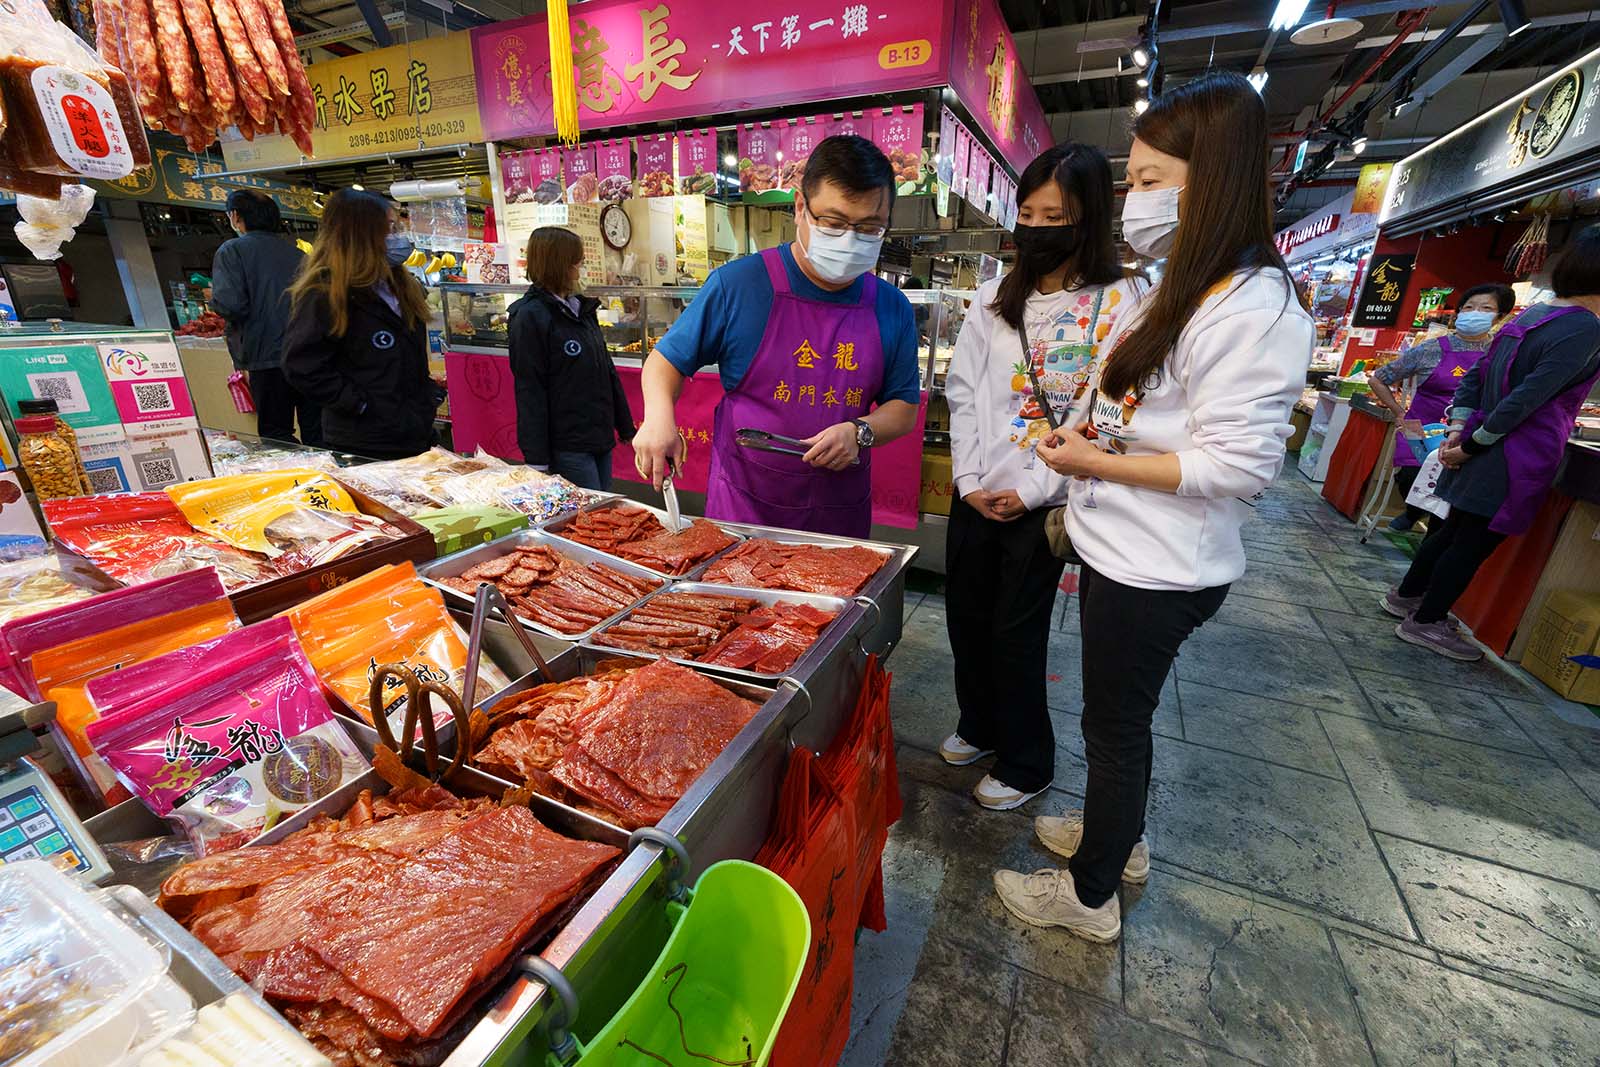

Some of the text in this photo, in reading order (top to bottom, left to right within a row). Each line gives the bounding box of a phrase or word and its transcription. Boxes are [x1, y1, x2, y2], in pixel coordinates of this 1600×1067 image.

[888, 46, 921, 64] B-13
[349, 119, 466, 148] 2396-4213/0928-420-329
[1372, 258, 1403, 302] 金龍
[793, 339, 859, 371] 金龍
[1093, 400, 1122, 420] AIWAN
